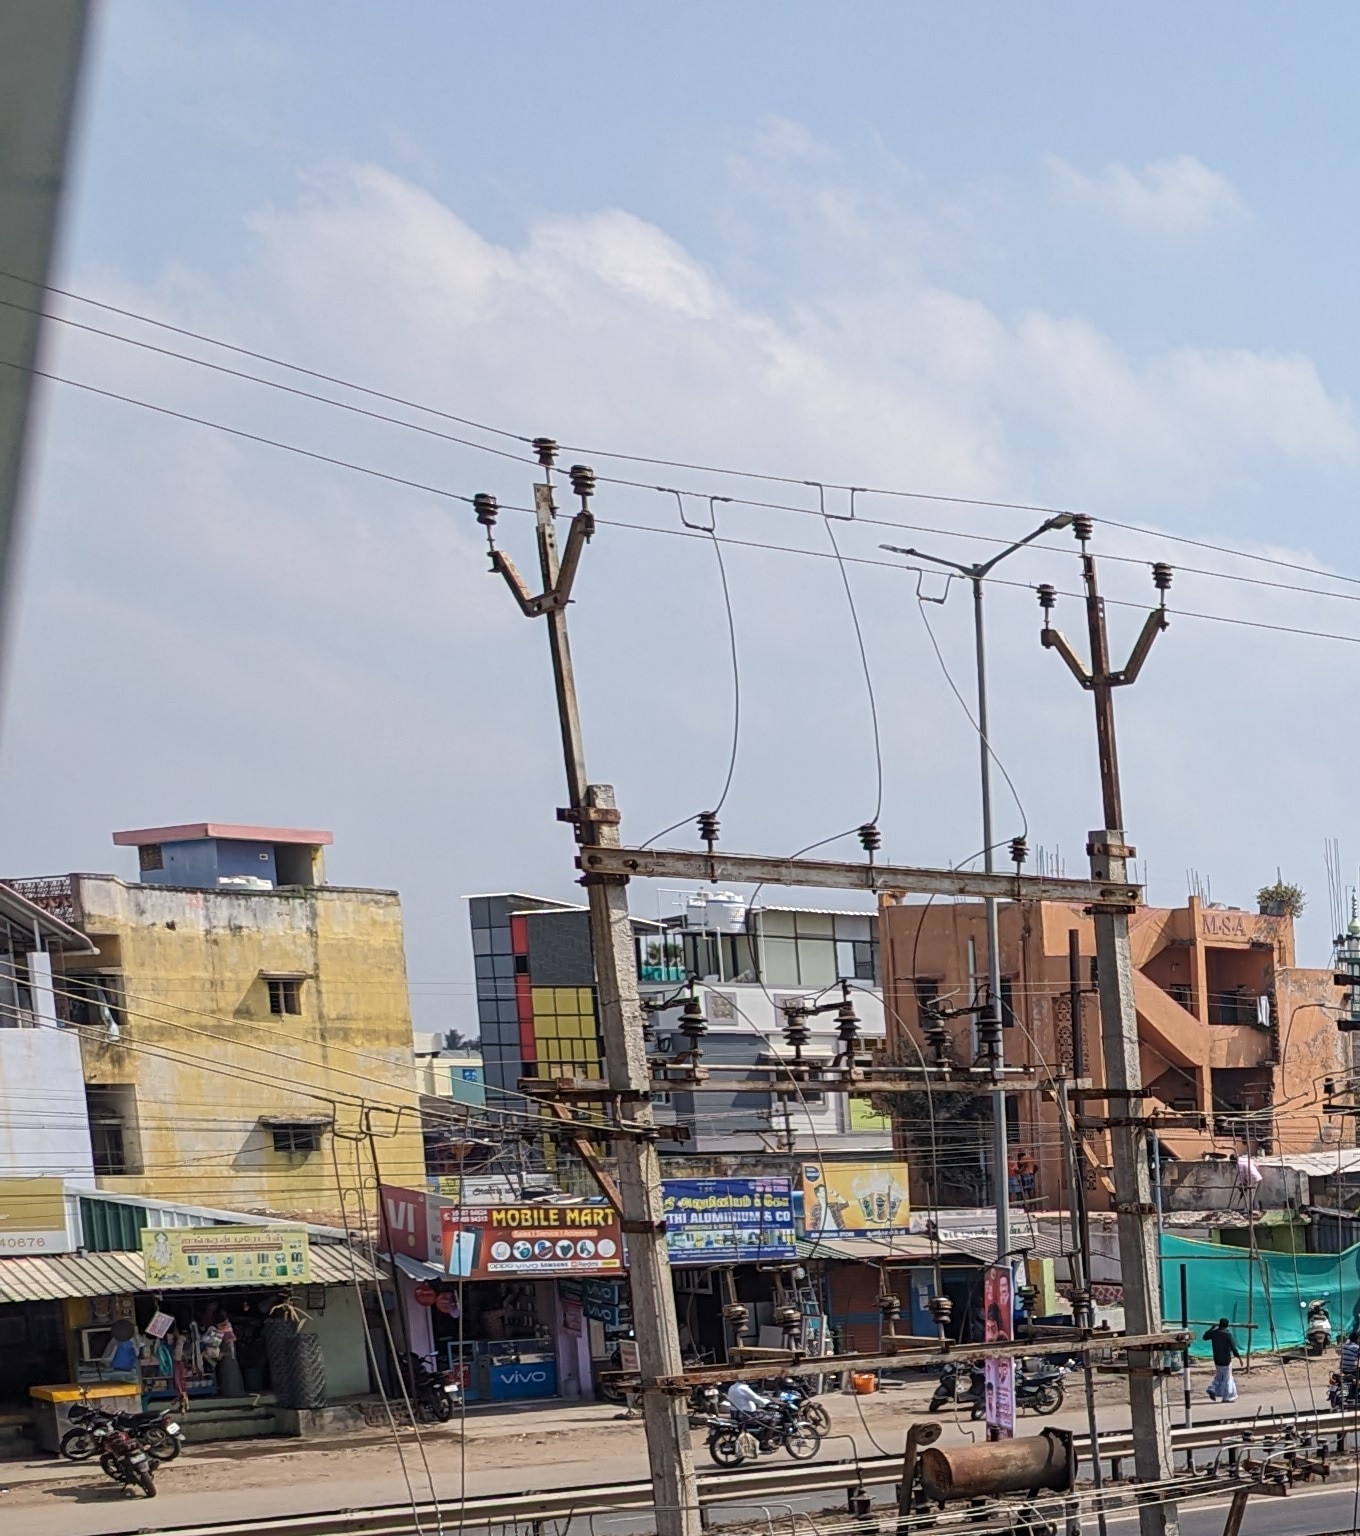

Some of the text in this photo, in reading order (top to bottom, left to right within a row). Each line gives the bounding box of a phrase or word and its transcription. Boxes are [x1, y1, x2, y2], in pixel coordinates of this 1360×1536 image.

[492, 1208, 615, 1228] MOBILE MART
[690, 1211, 760, 1224] ALUMINIUM
[775, 1210, 791, 1222] CO
[500, 1370, 547, 1384] vivo
